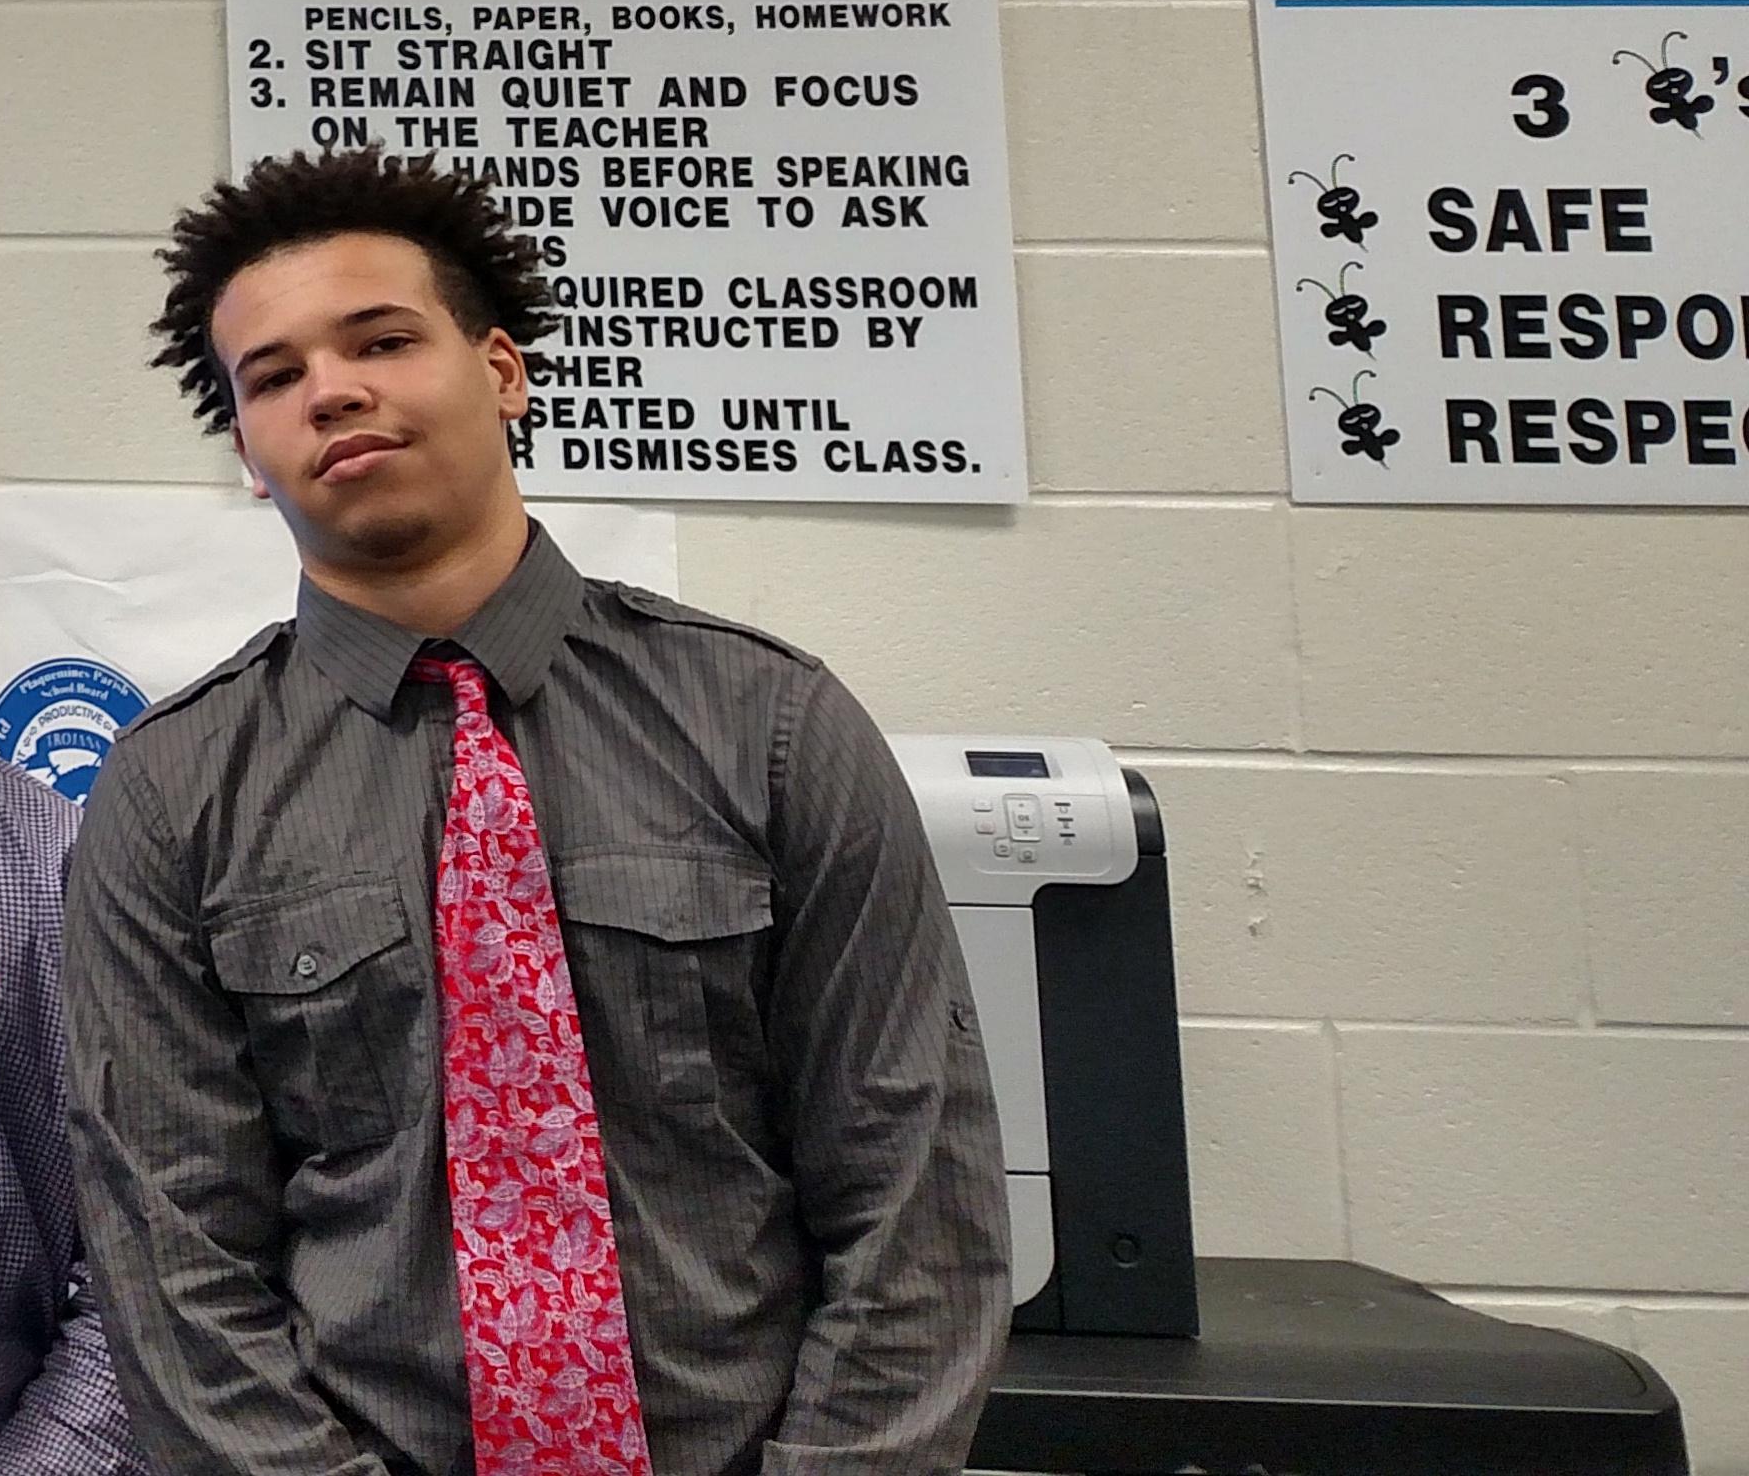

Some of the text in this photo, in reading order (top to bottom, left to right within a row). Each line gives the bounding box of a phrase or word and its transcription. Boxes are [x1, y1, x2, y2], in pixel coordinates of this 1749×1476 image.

[306, 3, 950, 36] PENCILS, PAPER, BOOKS, HOMEWORK
[249, 39, 612, 70] 2. SIT STRAIGHT
[250, 75, 918, 109] 3. REMAIN QUIET AND FOCUS
[1512, 75, 1569, 138] 3
[311, 117, 708, 148] ON THE TEACHER
[453, 155, 580, 188] HANDS
[604, 157, 753, 188] BEFORE
[777, 155, 969, 187] SPEAKING
[600, 196, 729, 228] VOICE
[757, 196, 813, 228] TO
[842, 196, 928, 227] ASK
[1428, 187, 1652, 252] SAFE
[536, 276, 977, 310] QUIRED CLASSROOM
[563, 317, 922, 349] INSTRUCTED BY
[1437, 294, 1749, 360] RESPO
[525, 356, 643, 389] CHER
[525, 399, 849, 431] SEATED UNTIL
[1446, 398, 1749, 465] RESPE
[563, 438, 797, 471] DISMISSES
[827, 440, 980, 473] CLASS.
[38, 705, 104, 727] PRODUCTIVE
